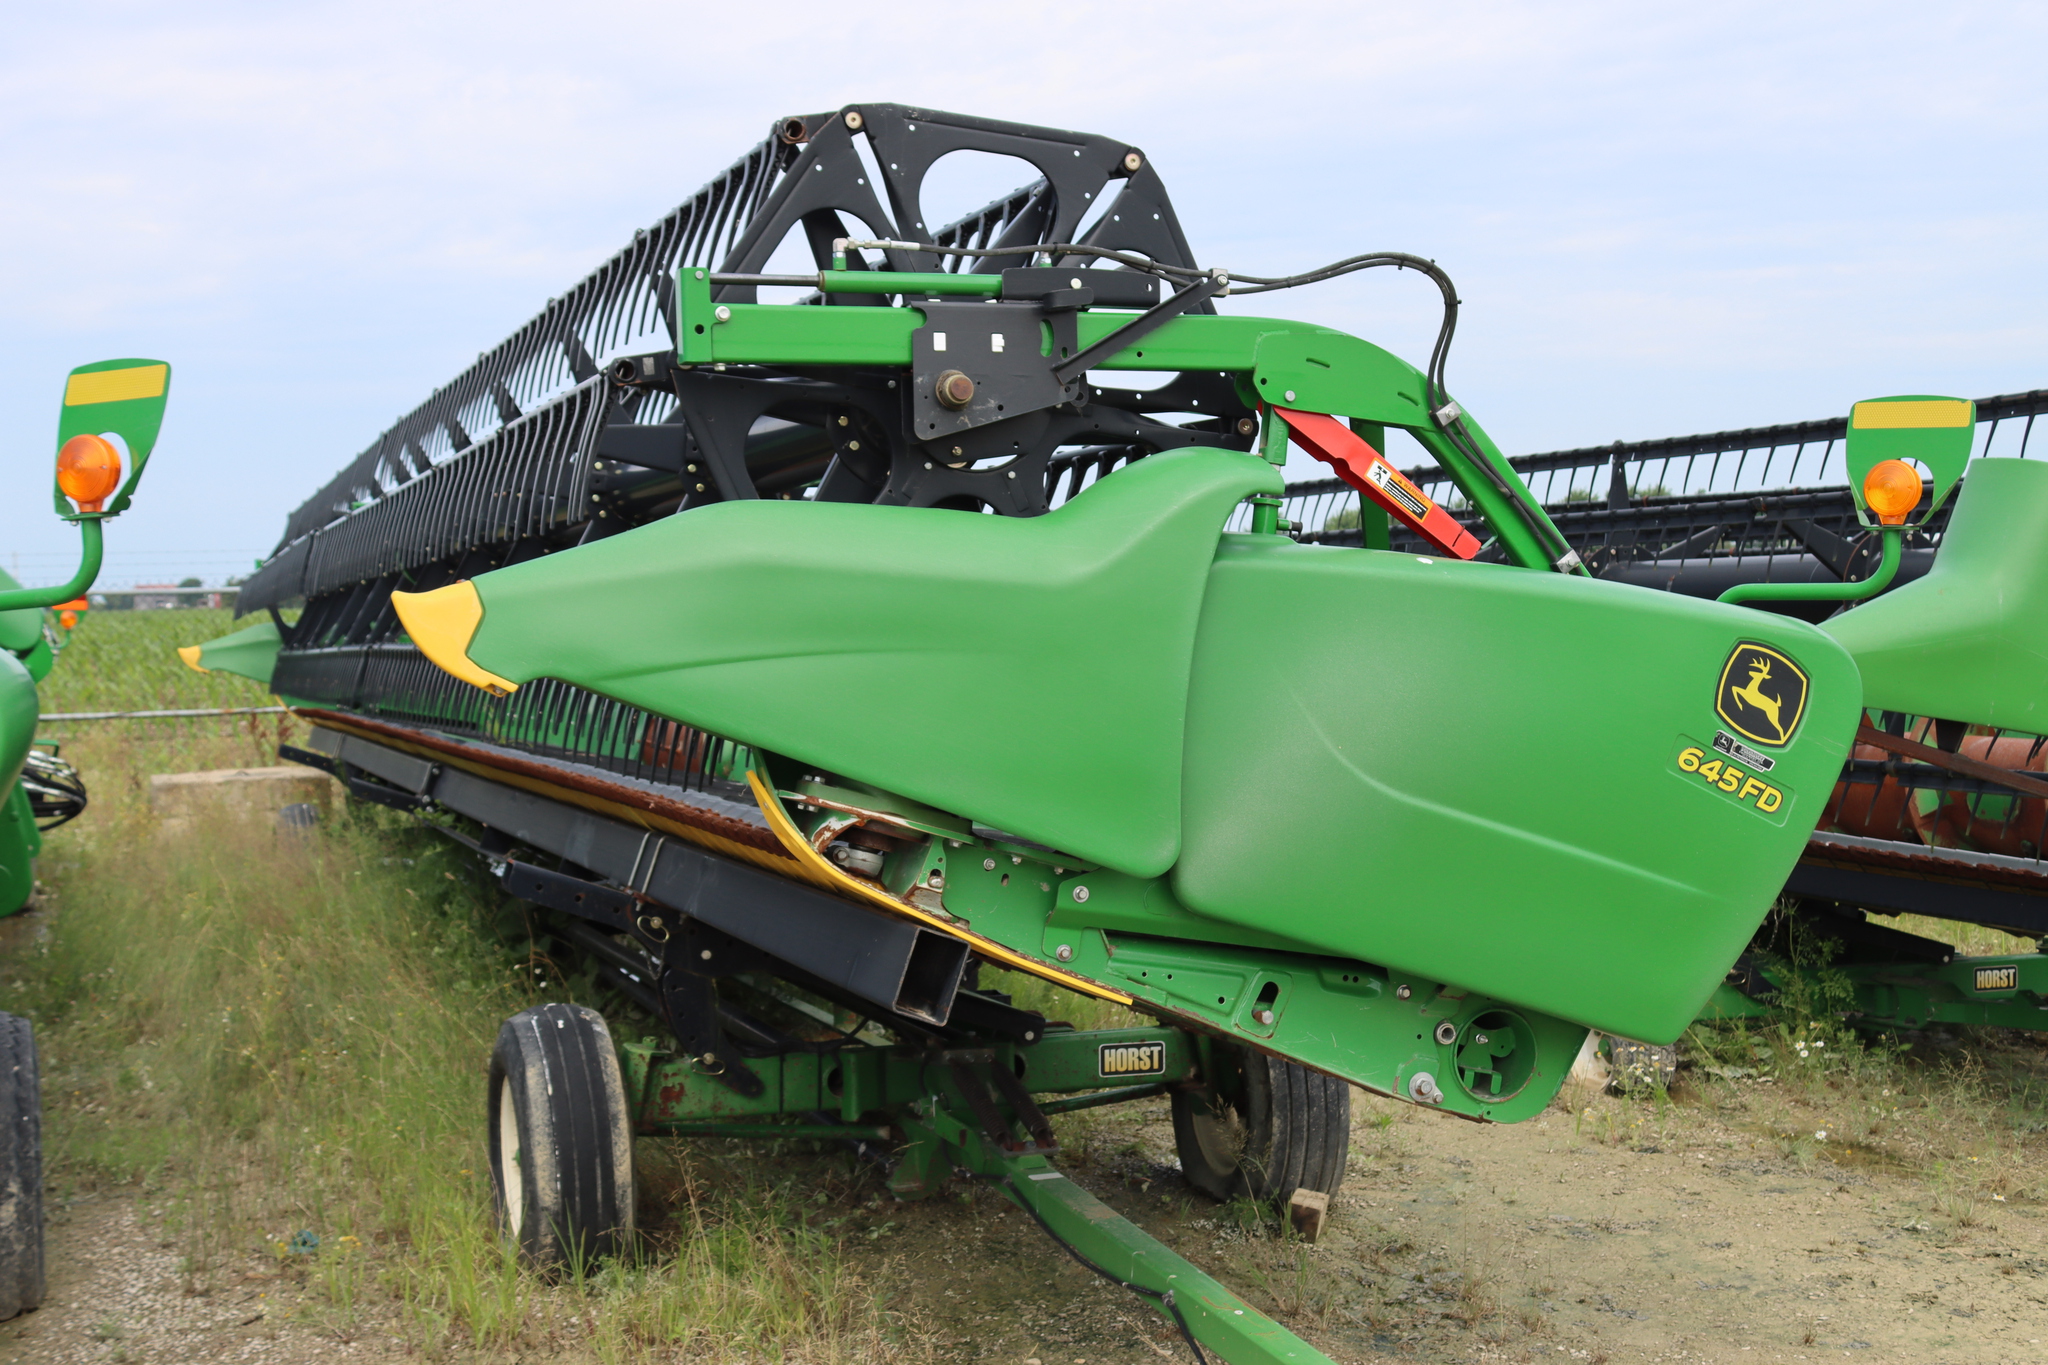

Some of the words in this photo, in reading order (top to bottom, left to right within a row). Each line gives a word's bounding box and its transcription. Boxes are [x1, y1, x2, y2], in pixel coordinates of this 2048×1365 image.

[1403, 482, 1426, 503] WARNING
[1677, 746, 1783, 814] 645FD
[1976, 968, 2016, 989] HORST
[1104, 1046, 1162, 1073] HORST
